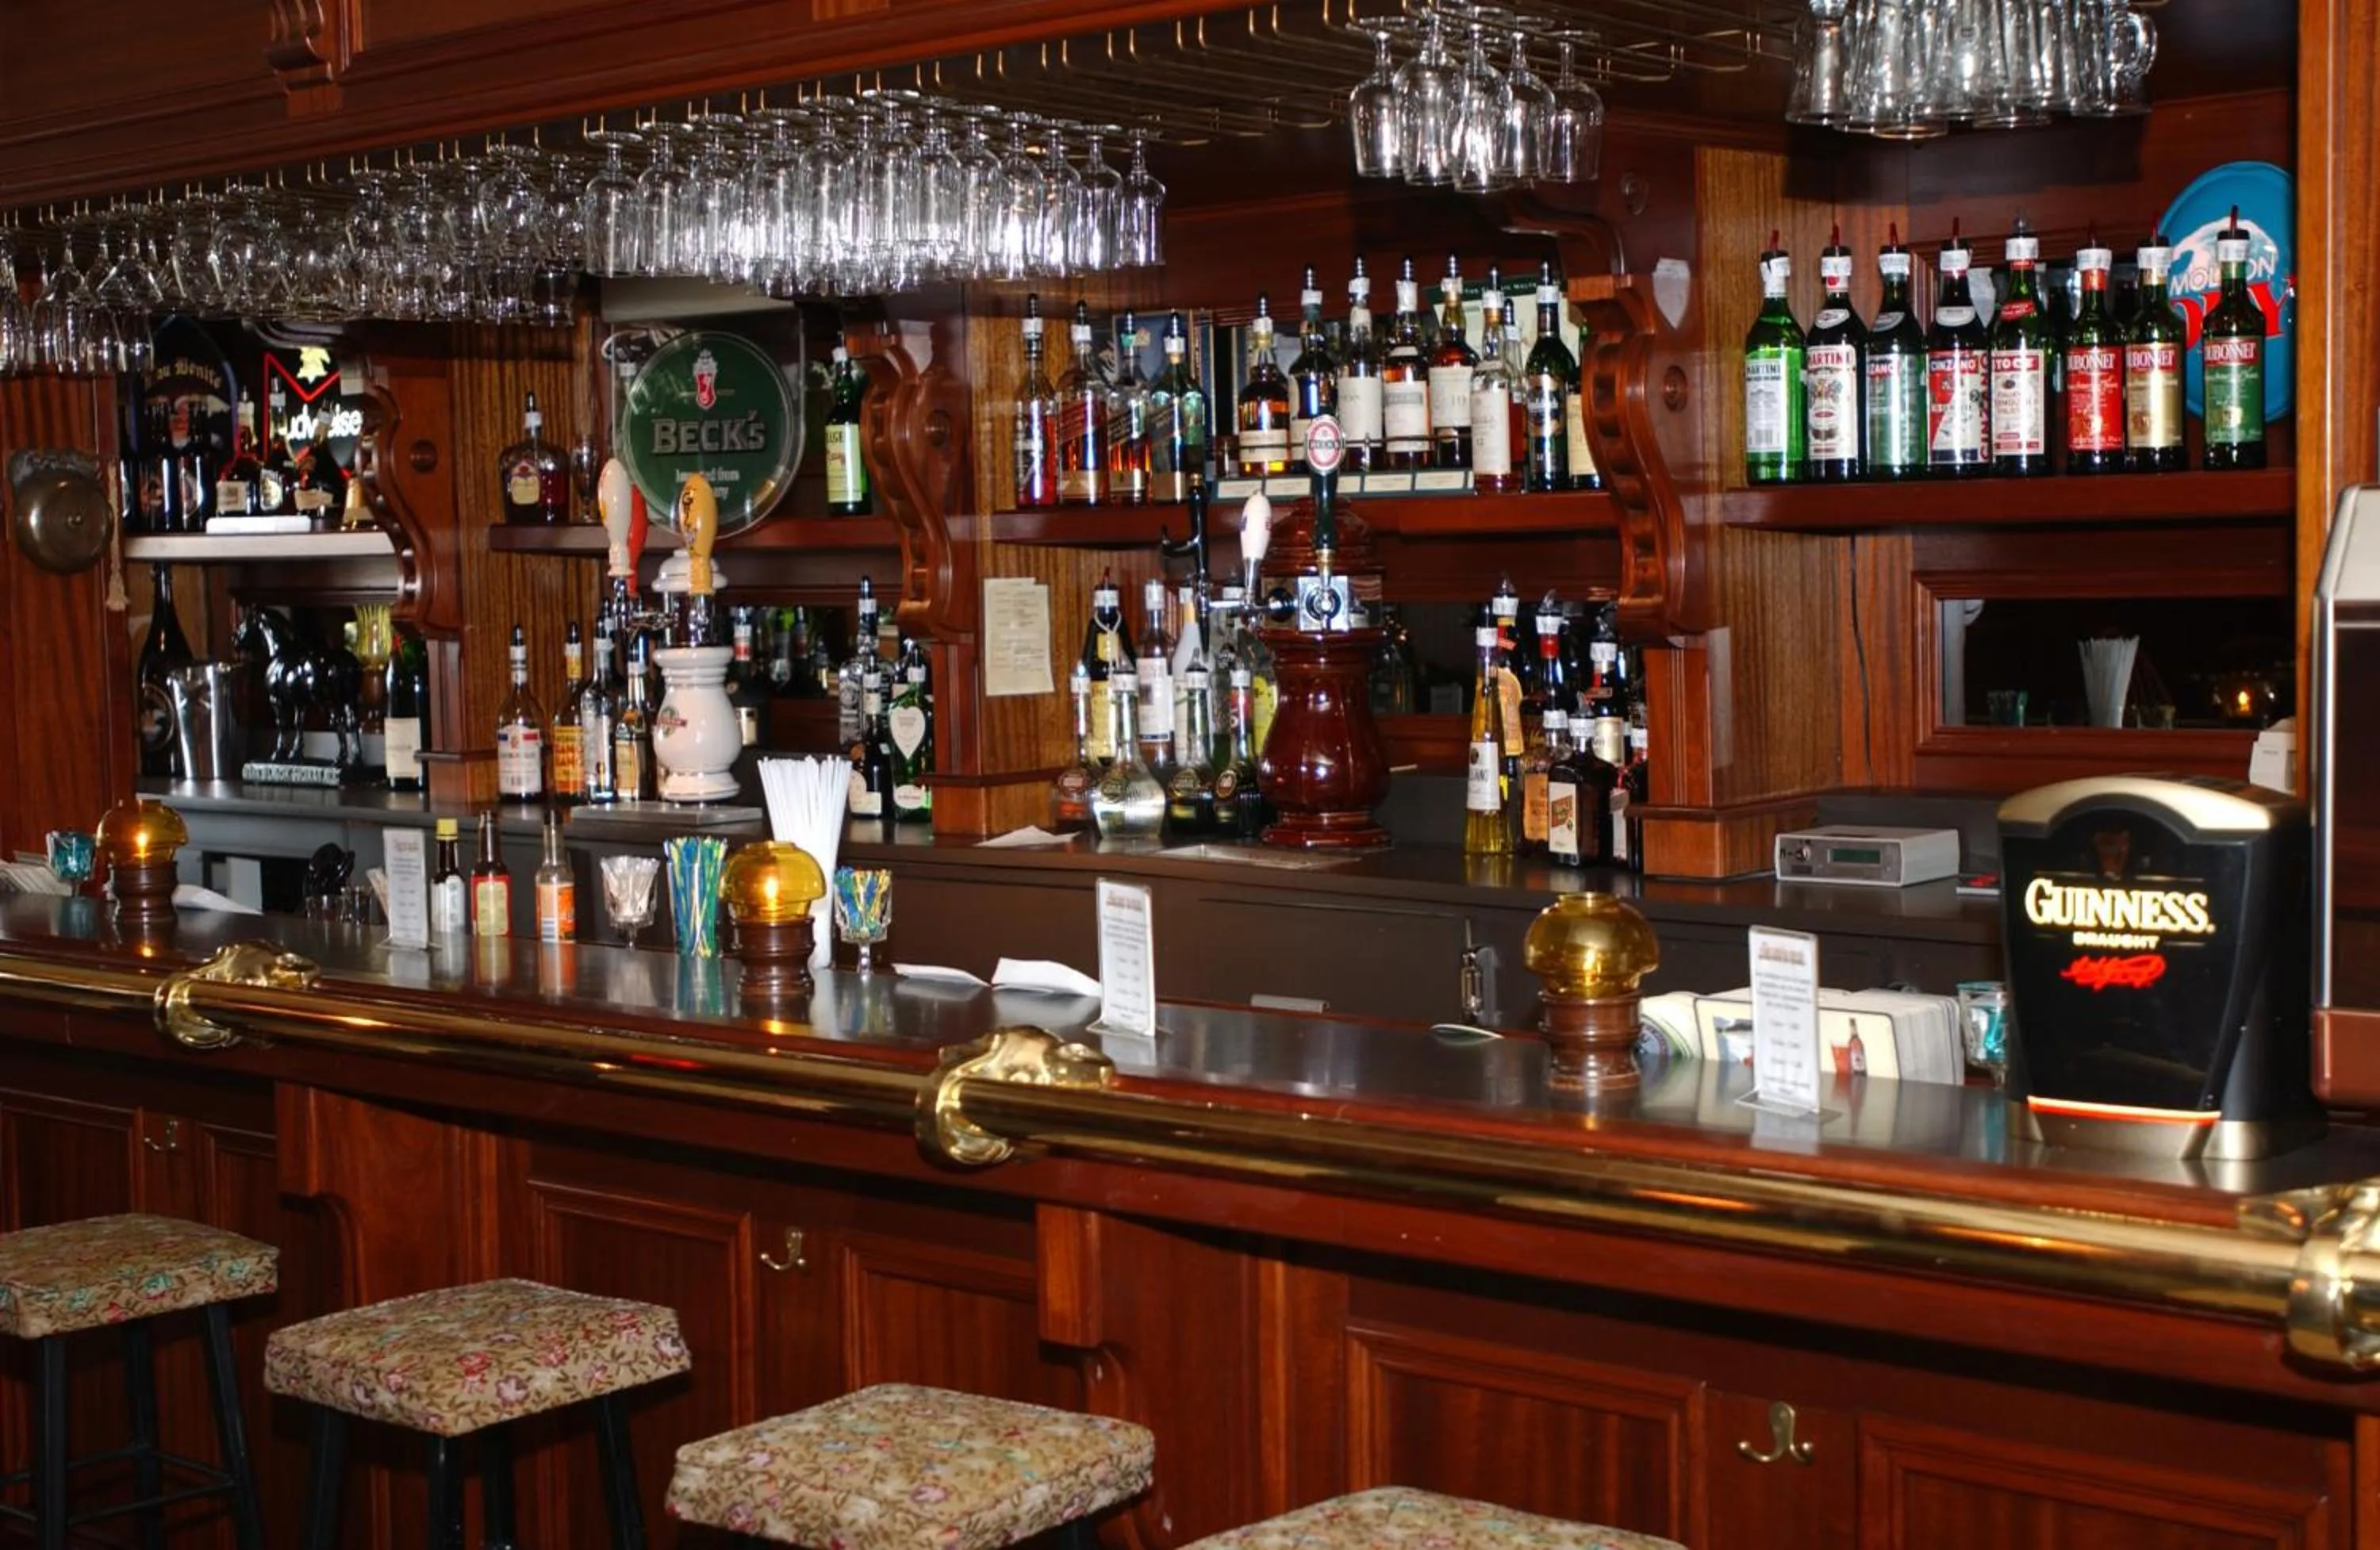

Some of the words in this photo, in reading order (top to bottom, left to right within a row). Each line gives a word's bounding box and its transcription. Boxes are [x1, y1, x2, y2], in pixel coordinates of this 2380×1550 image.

[2170, 256, 2275, 297] MOLON
[2170, 274, 2297, 351] DY
[2025, 877, 2209, 934] GUINNESS
